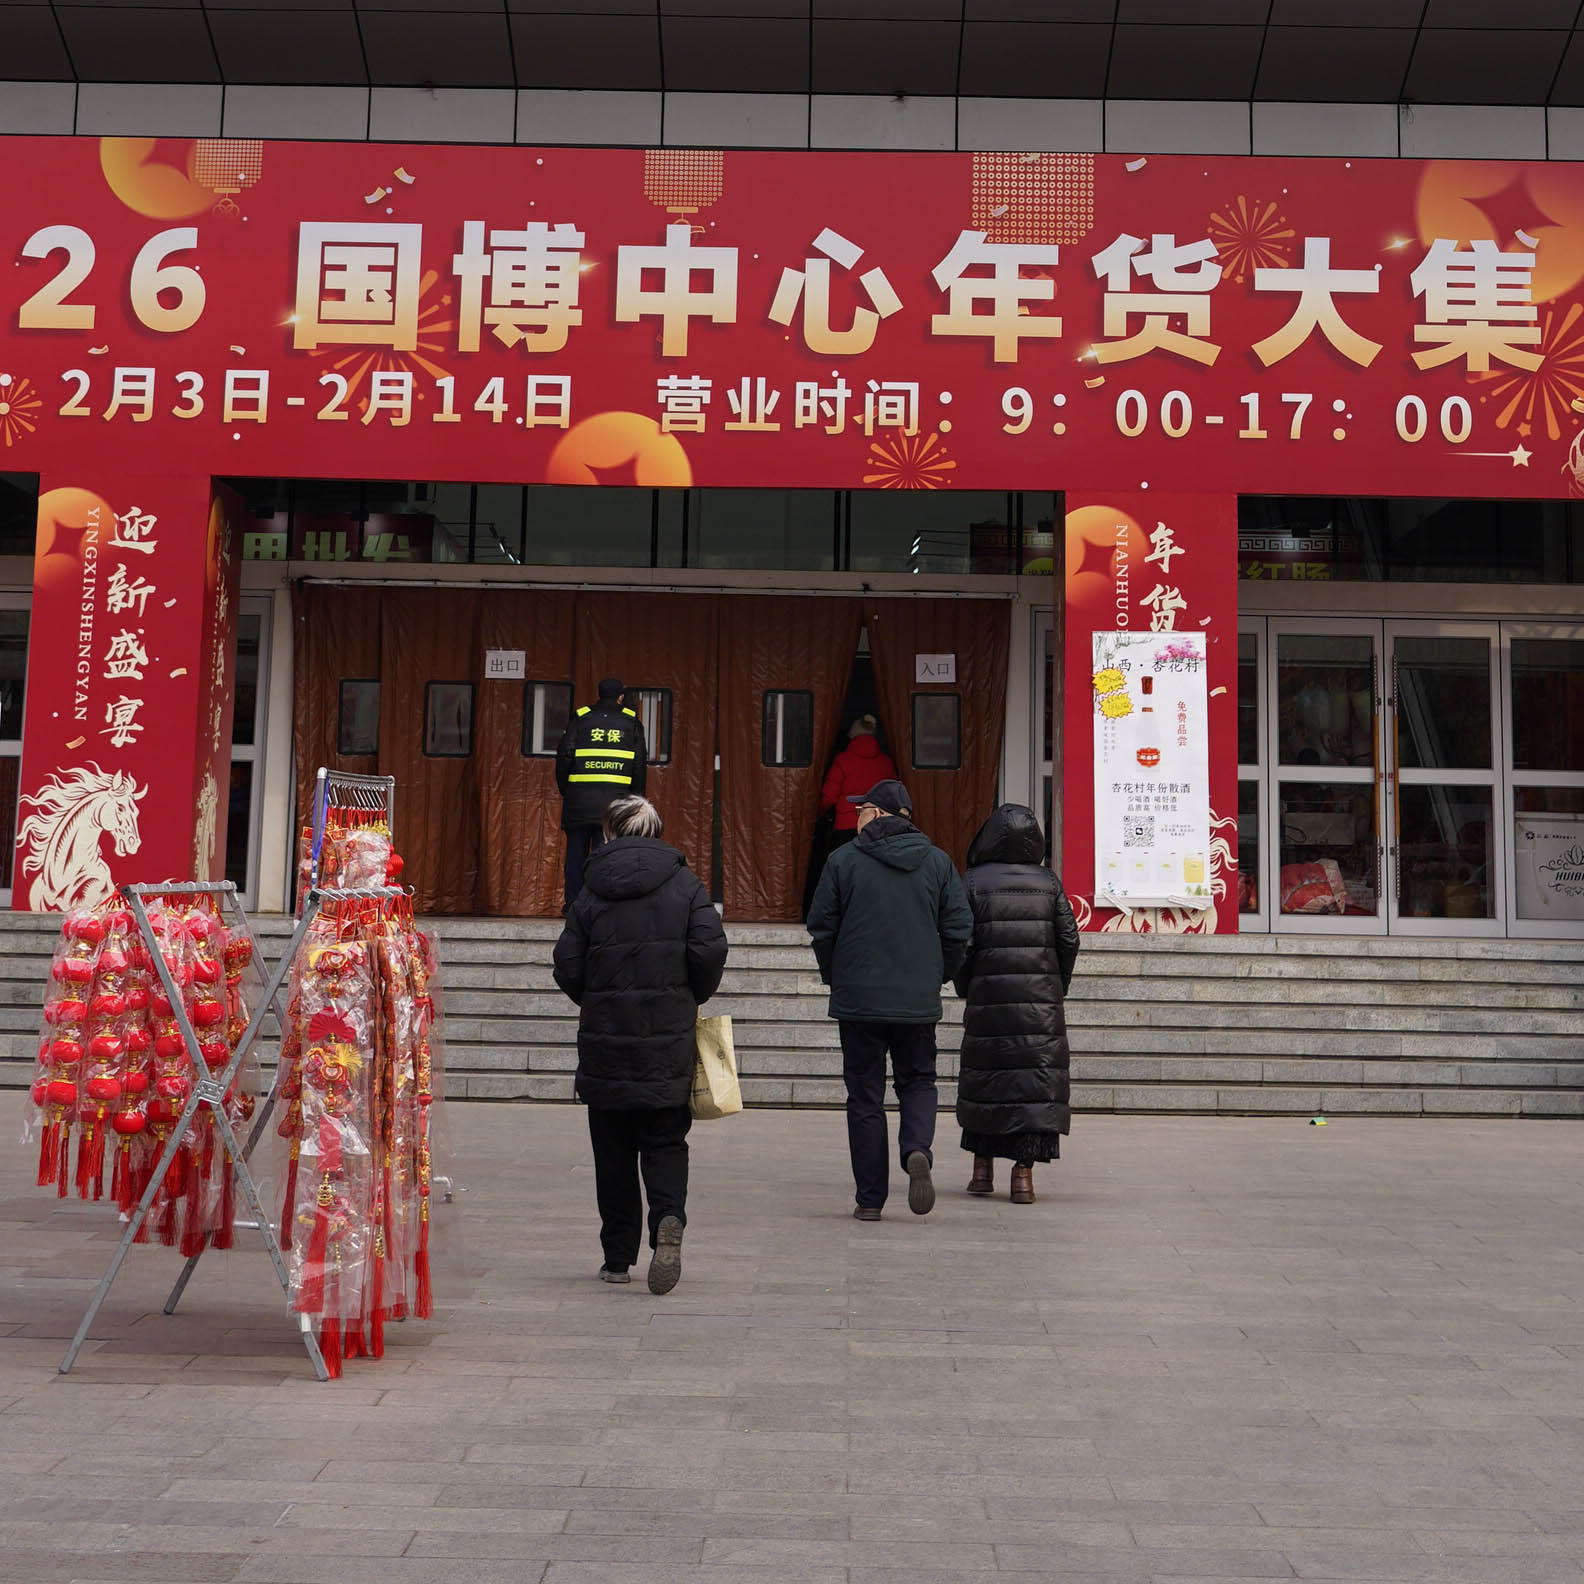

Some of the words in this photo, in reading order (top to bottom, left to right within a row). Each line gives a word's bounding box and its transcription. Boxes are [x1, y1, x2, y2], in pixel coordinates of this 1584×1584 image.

[292, 220, 1547, 372] 国博中心年货大集
[1116, 524, 1129, 632] NIANHUO
[74, 506, 100, 721] YINGXINSHENGYAN
[98, 506, 159, 748] 迎新盛宴
[490, 657, 520, 673] 出口
[920, 662, 950, 677] 入口
[584, 761, 624, 771] SECURITY
[591, 729, 621, 744] 安保
